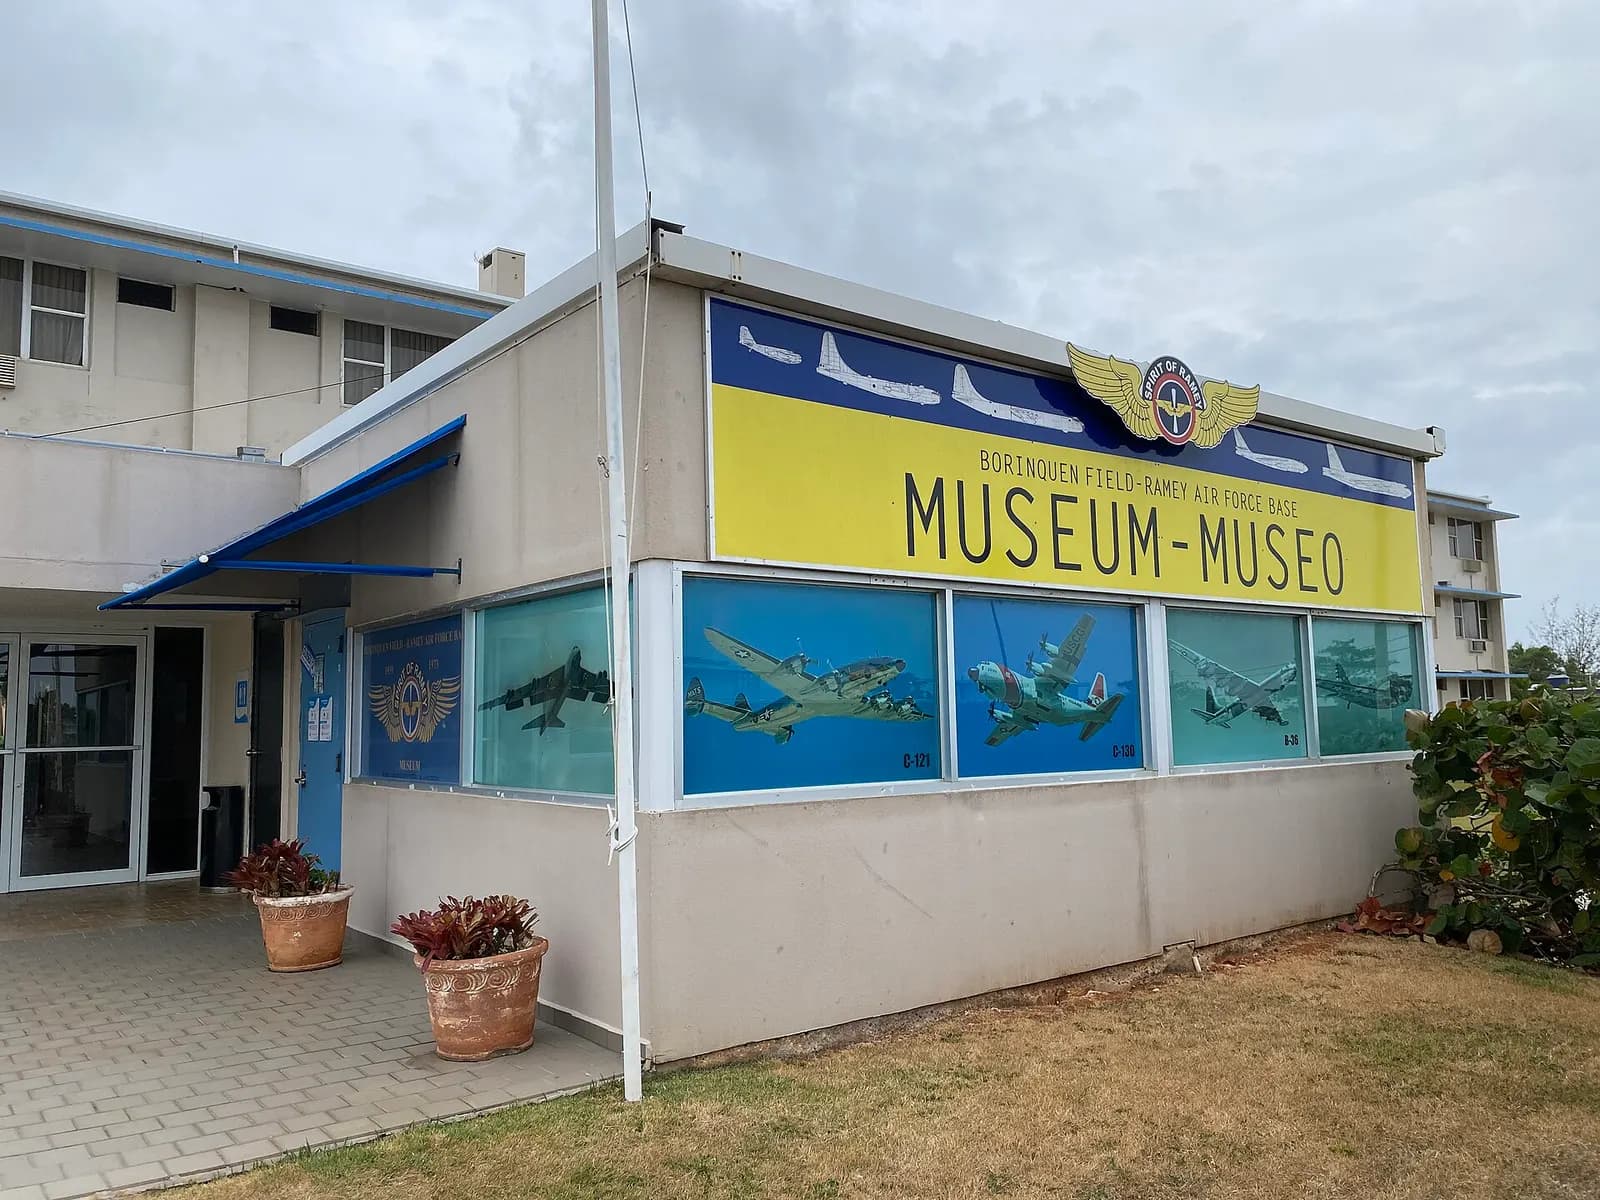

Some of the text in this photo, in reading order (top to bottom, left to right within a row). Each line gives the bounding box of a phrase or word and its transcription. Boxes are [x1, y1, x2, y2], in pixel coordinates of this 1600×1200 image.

[1145, 360, 1203, 409] SPIRIT OF RAMEY
[980, 449, 1080, 485] BORINQUEN
[1195, 484, 1220, 506] AIR
[1224, 489, 1264, 513] FORCE
[1269, 498, 1298, 519] BASE
[393, 669, 406, 709] SPIRIT
[406, 662, 414, 675] OF
[1112, 743, 1136, 759] C-130
[1284, 734, 1299, 746] B-36
[903, 752, 931, 769] C-121
